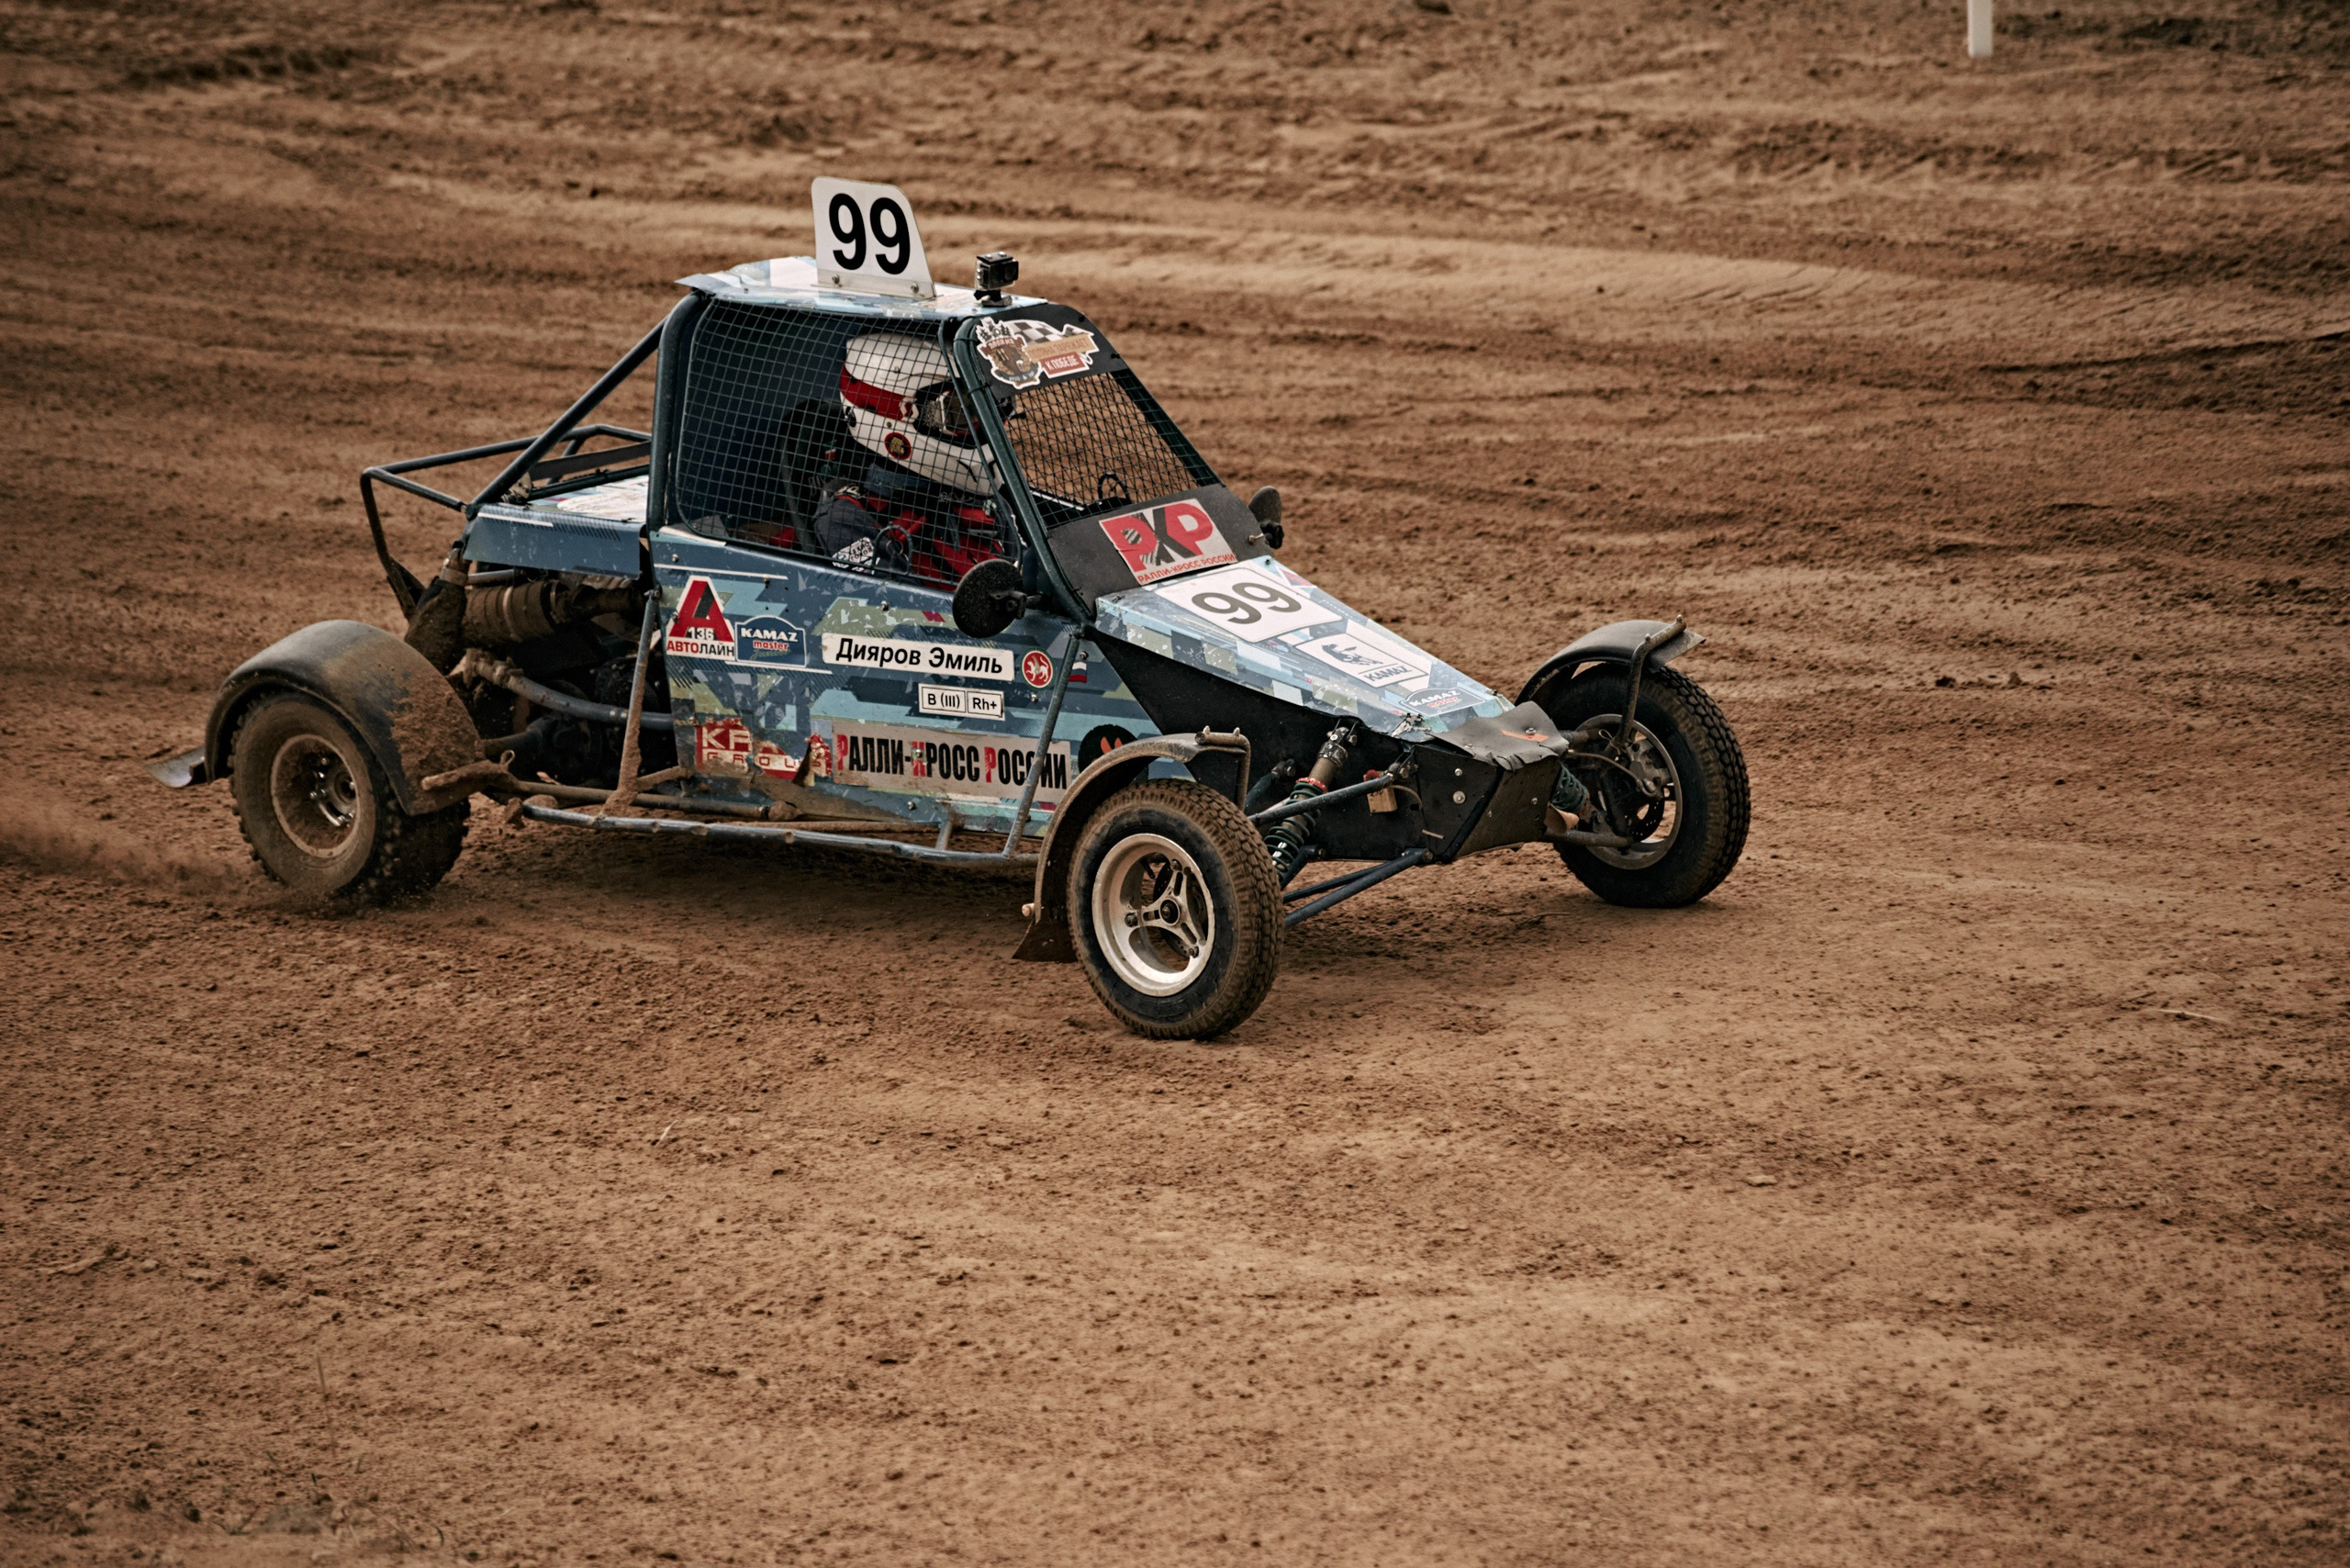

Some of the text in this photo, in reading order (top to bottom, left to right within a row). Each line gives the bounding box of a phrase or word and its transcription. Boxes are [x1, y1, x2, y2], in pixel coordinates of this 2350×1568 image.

[829, 193, 911, 275] 99
[1045, 354, 1080, 371] К ПОБЕДЕ
[1137, 554, 1237, 583] РАЛЛИ-КРОСС РОССИИ
[1192, 582, 1302, 624] 99
[688, 627, 715, 641] 136
[741, 628, 799, 642] KAMAZ
[666, 641, 734, 656] АВТОЛАЙН
[753, 640, 789, 651] master
[836, 638, 1002, 674] Дияров Эмиль
[1364, 666, 1412, 681] KAMAZ
[973, 698, 998, 710] Rh+
[1408, 690, 1460, 707] KAMAZ
[836, 734, 980, 782] РАЛЛИ-КРОСС
